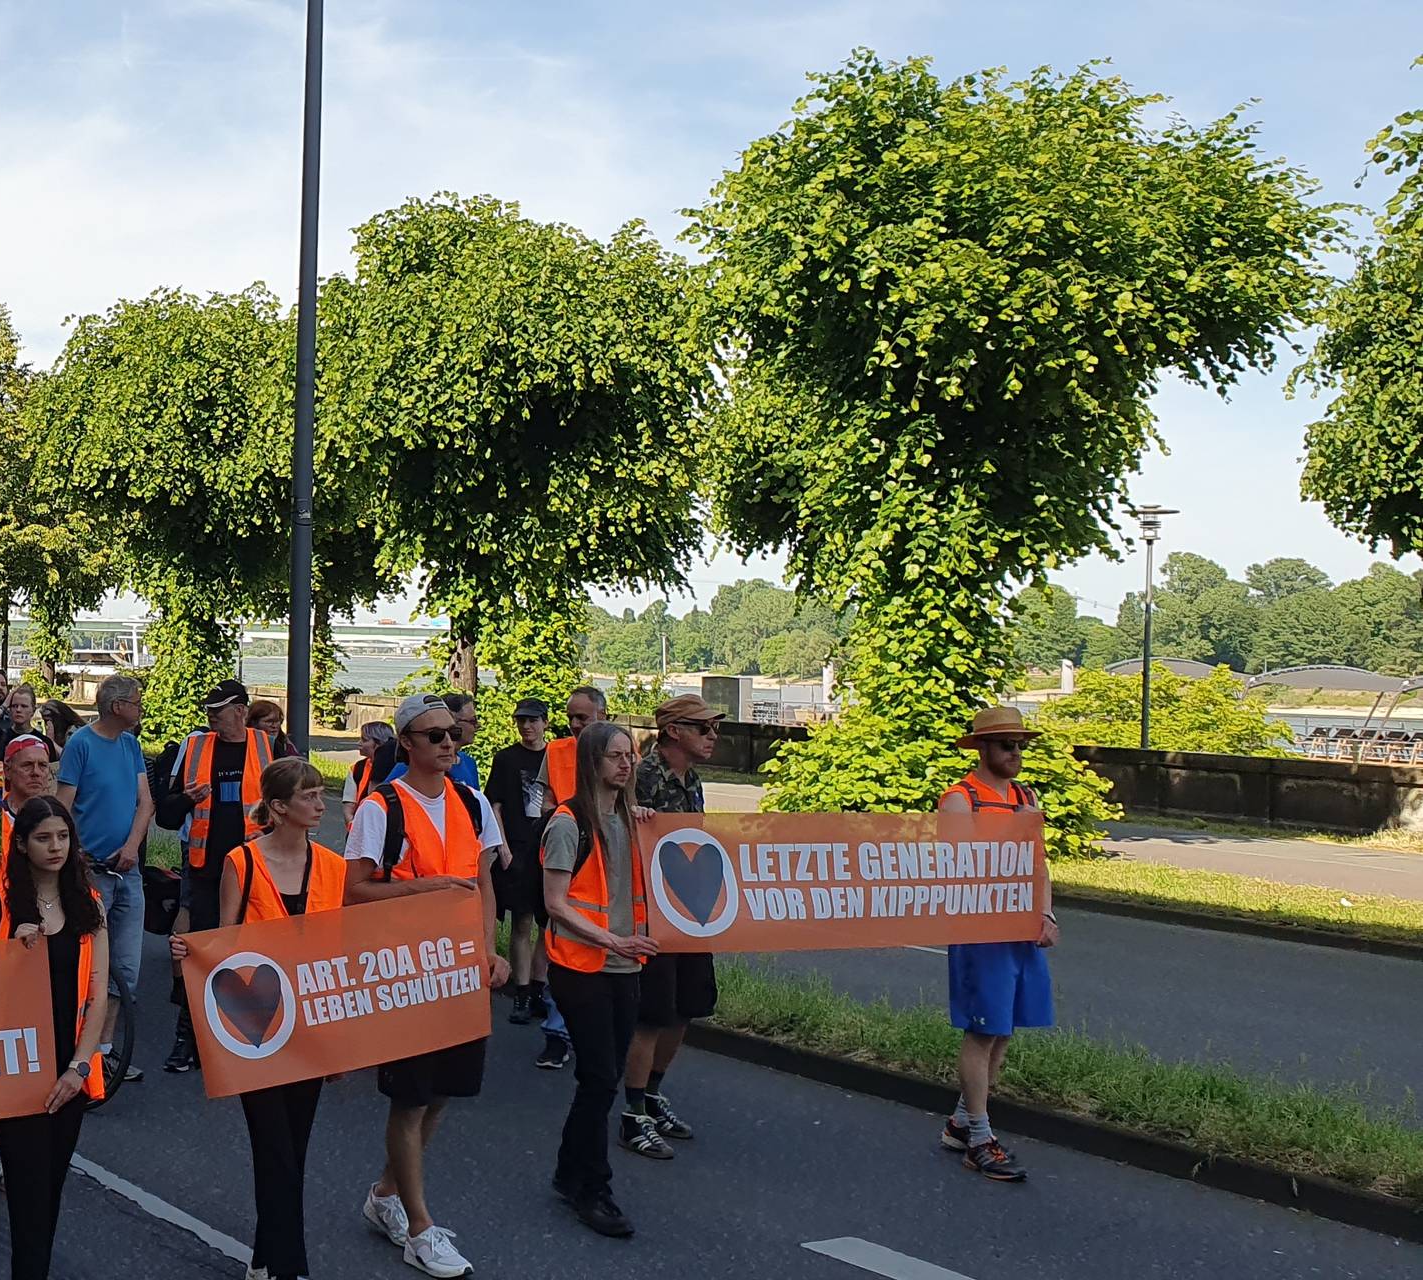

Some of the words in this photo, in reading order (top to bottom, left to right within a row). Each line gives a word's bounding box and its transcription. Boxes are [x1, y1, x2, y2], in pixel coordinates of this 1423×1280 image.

[738, 842, 852, 883] LETZTE
[858, 840, 1035, 882] GENERATION
[743, 886, 807, 921] VOR
[809, 885, 865, 920] DEN
[870, 881, 1035, 919] KIPPPUNKTEN
[296, 955, 357, 996] ART.
[359, 944, 417, 984] 20A
[418, 936, 456, 972] GG
[302, 988, 374, 1027] LEBEN
[377, 964, 482, 1012] SCHÜTZEN
